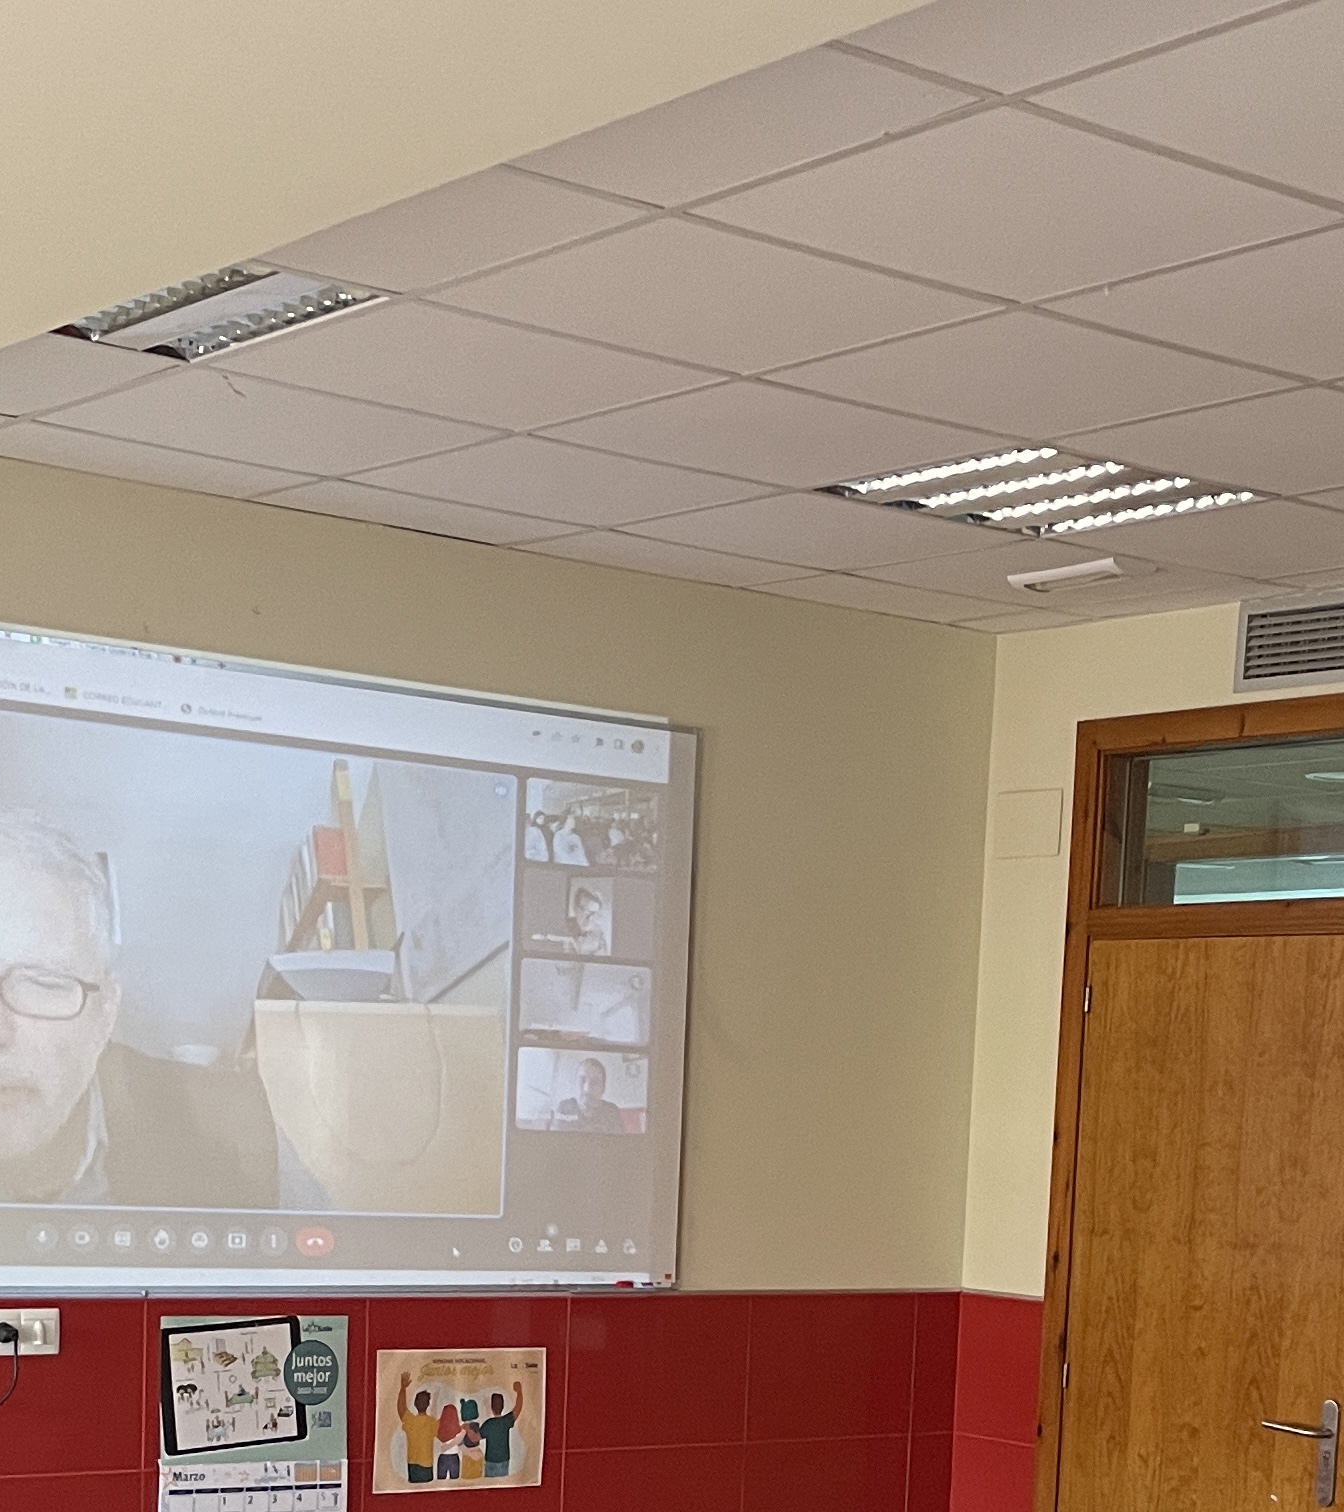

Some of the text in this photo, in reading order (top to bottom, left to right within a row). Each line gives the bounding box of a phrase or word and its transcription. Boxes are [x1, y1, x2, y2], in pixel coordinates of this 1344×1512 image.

[291, 1352, 333, 1370] Juntos
[293, 1368, 331, 1386] mejor
[173, 1472, 205, 1481] Marzo
[223, 1497, 226, 1505] 1
[248, 1496, 253, 1505] 2
[272, 1495, 277, 1503] 3
[296, 1493, 302, 1502] 4
